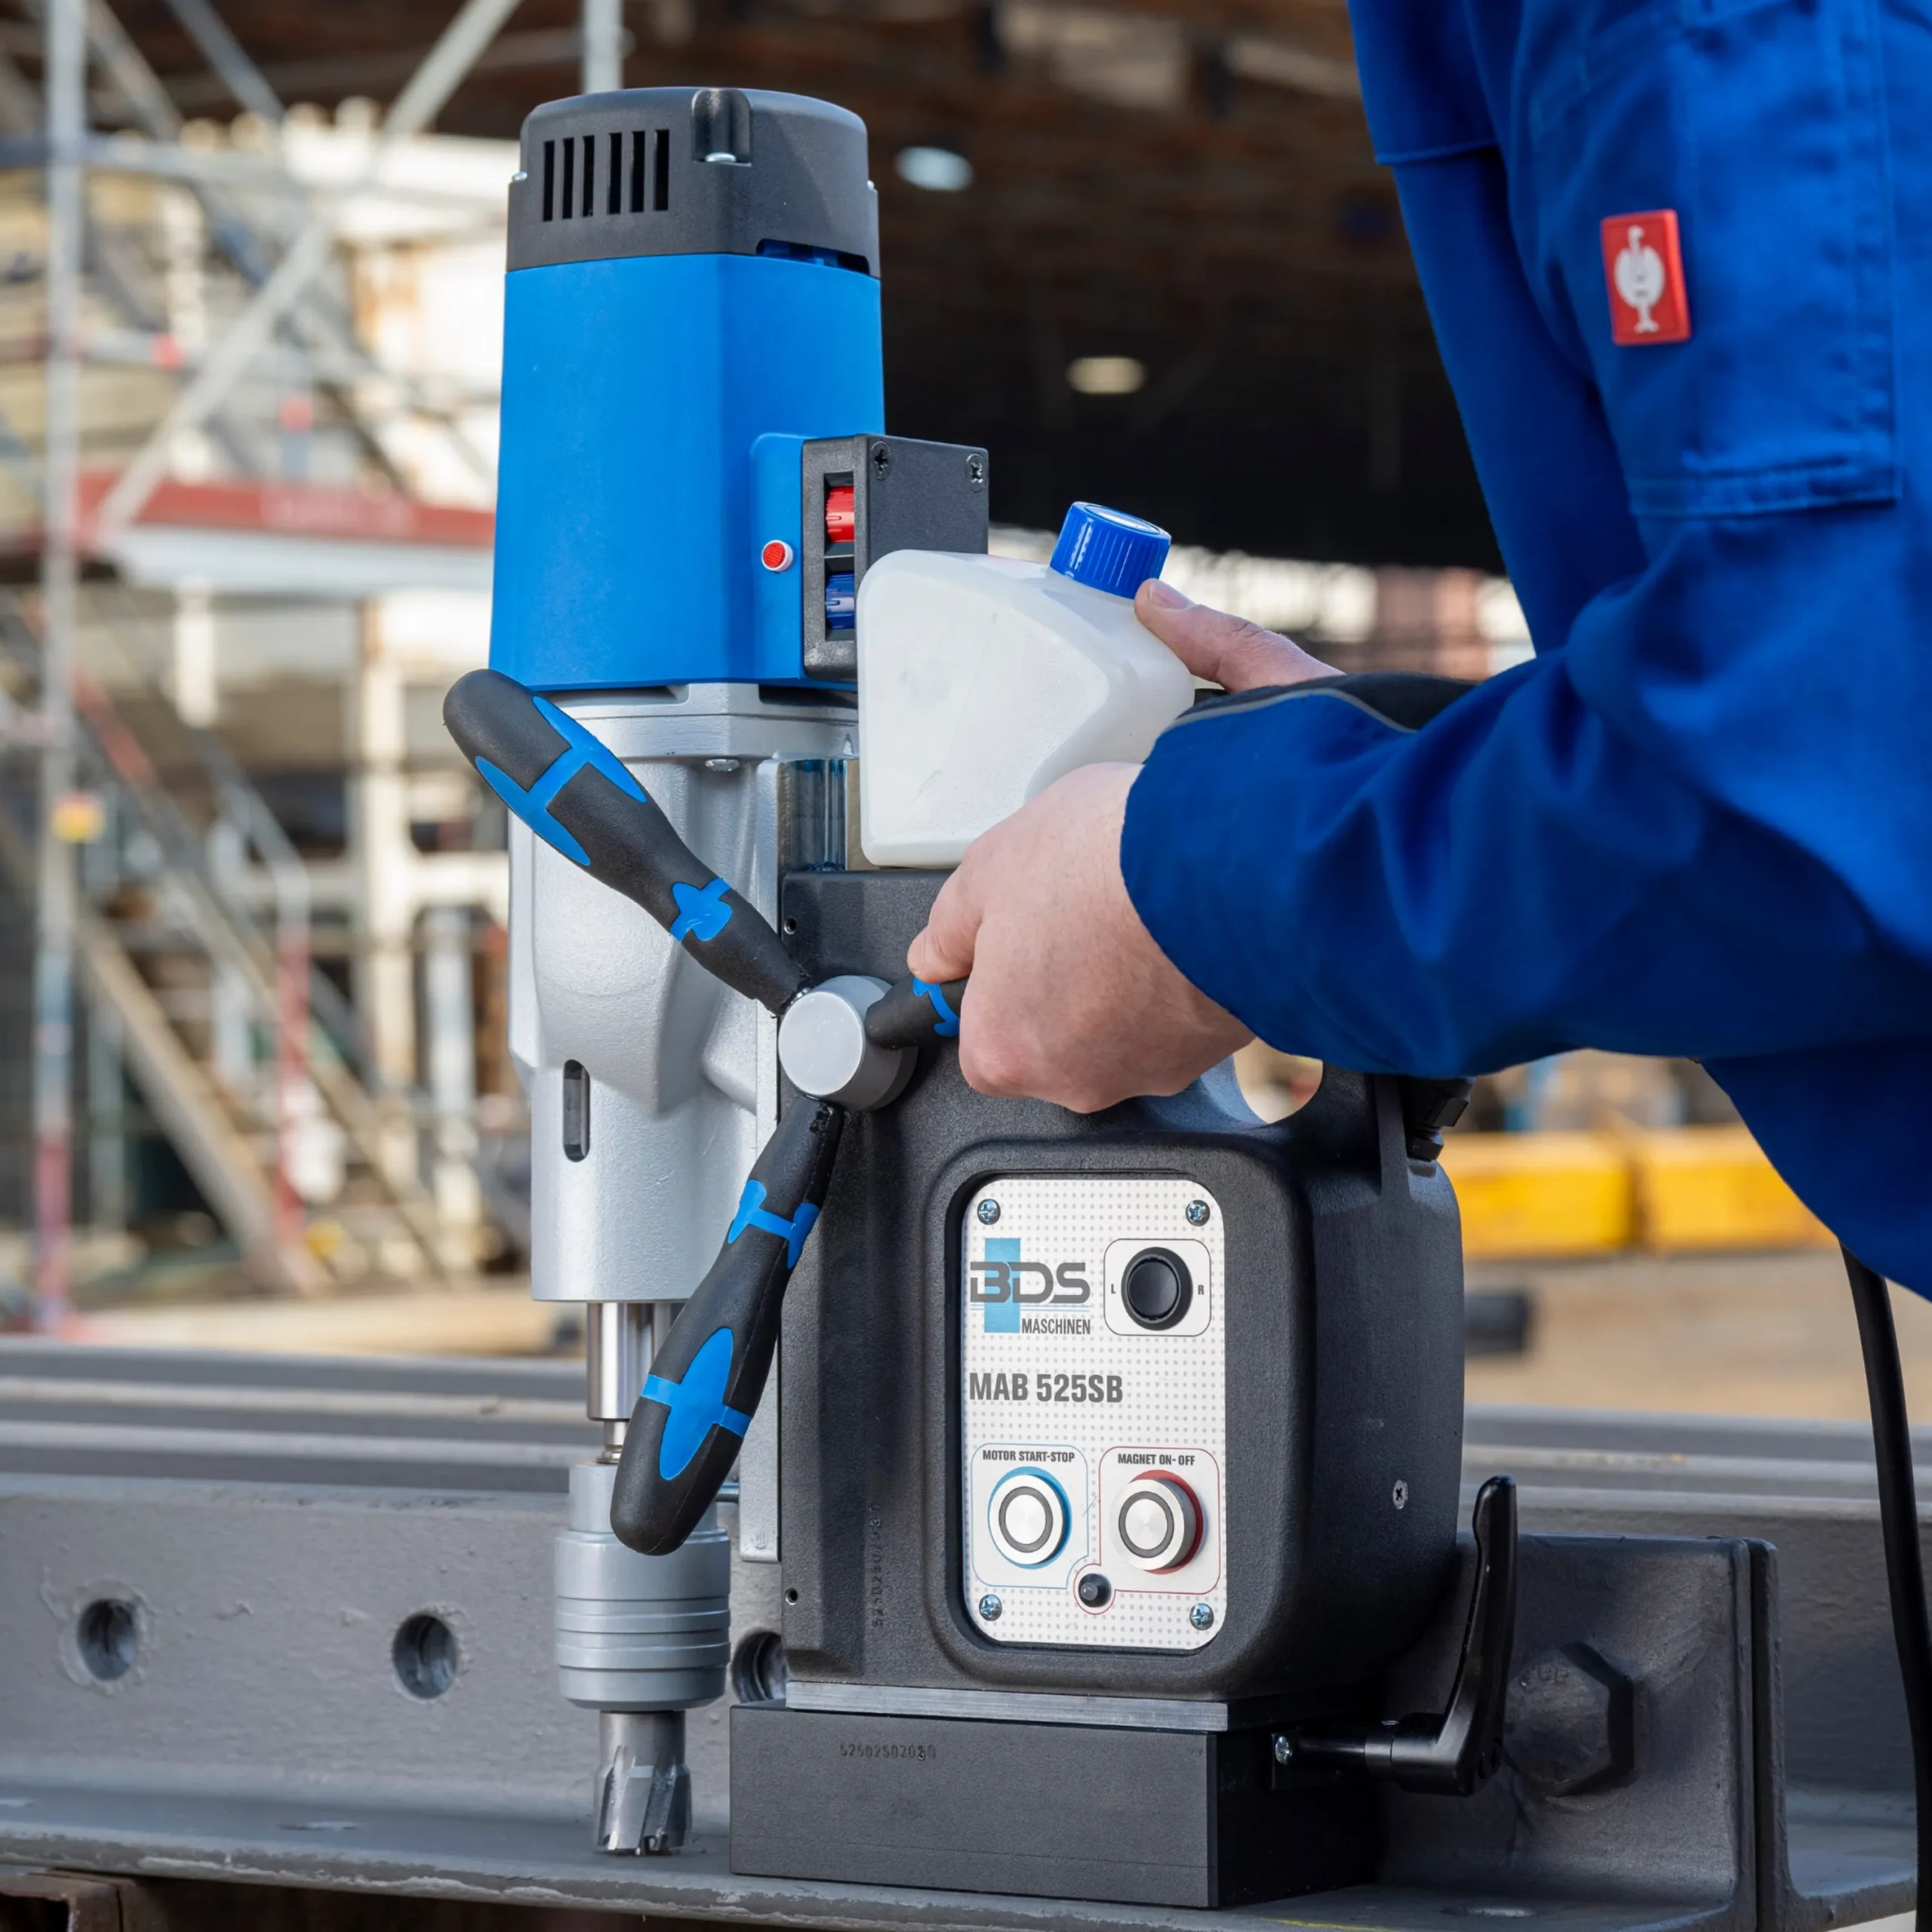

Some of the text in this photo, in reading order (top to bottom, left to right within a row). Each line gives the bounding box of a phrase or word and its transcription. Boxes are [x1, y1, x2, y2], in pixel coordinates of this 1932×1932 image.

[970, 1261, 1091, 1304] BDS
[1110, 1284, 1116, 1295] L
[1197, 1284, 1205, 1296] R
[1021, 1318, 1091, 1335] MASCHINEN
[970, 1372, 1124, 1403] MAB 525SB
[982, 1450, 1075, 1463] MOTOR START-STOP
[1117, 1453, 1157, 1465] MAGNET
